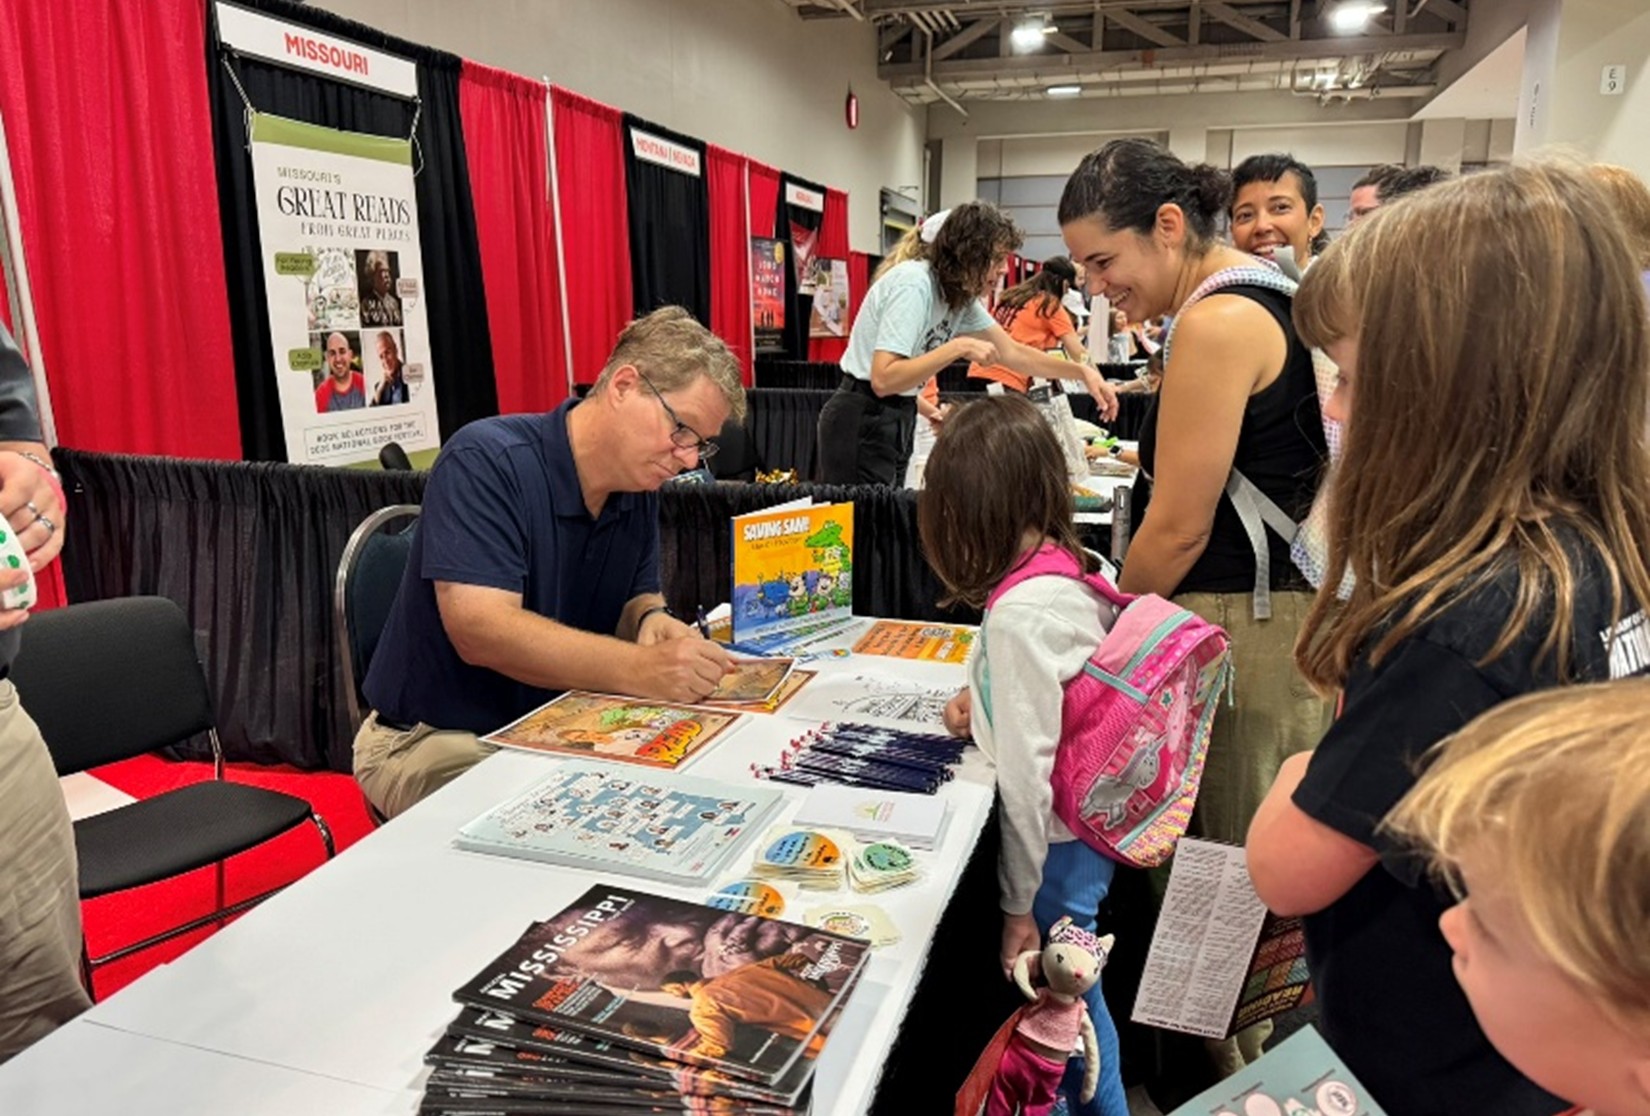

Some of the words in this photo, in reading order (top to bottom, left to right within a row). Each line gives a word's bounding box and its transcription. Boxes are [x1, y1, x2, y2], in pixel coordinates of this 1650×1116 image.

[284, 32, 369, 76] MISSOURI
[277, 186, 347, 220] GREAT
[352, 193, 411, 225] READS
[743, 519, 782, 542] SAVING
[487, 894, 629, 1000] MISSISSIPPI
